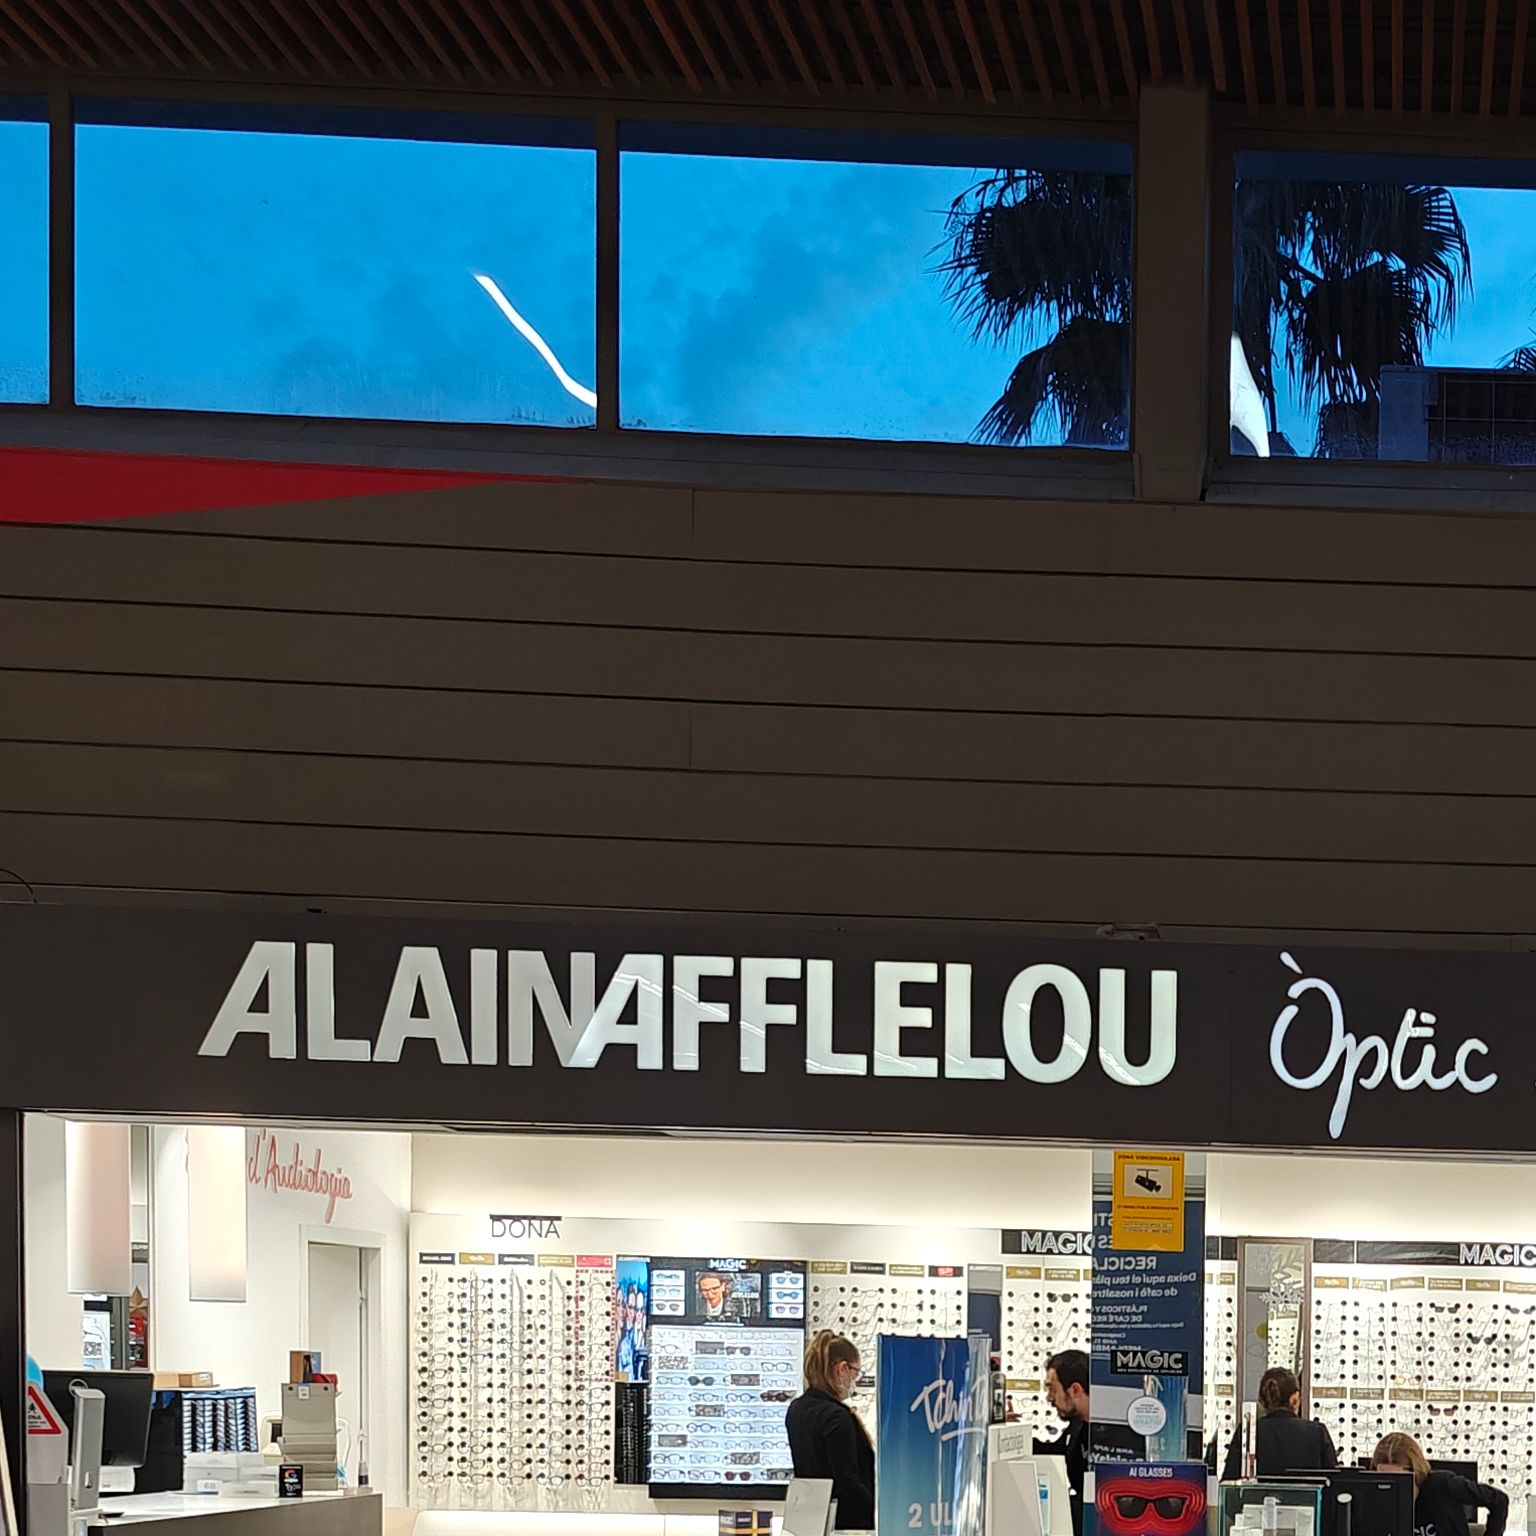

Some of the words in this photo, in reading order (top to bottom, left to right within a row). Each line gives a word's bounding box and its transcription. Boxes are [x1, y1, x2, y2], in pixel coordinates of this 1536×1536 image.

[1269, 951, 1497, 1139] Òptic
[491, 1218, 561, 1239] DONA
[709, 1258, 747, 1270] MAGIC
[1115, 1350, 1183, 1369] MAGIC
[1128, 1468, 1138, 1477] AI
[1138, 1467, 1173, 1478] GLASSES
[907, 1502, 923, 1529] 2
